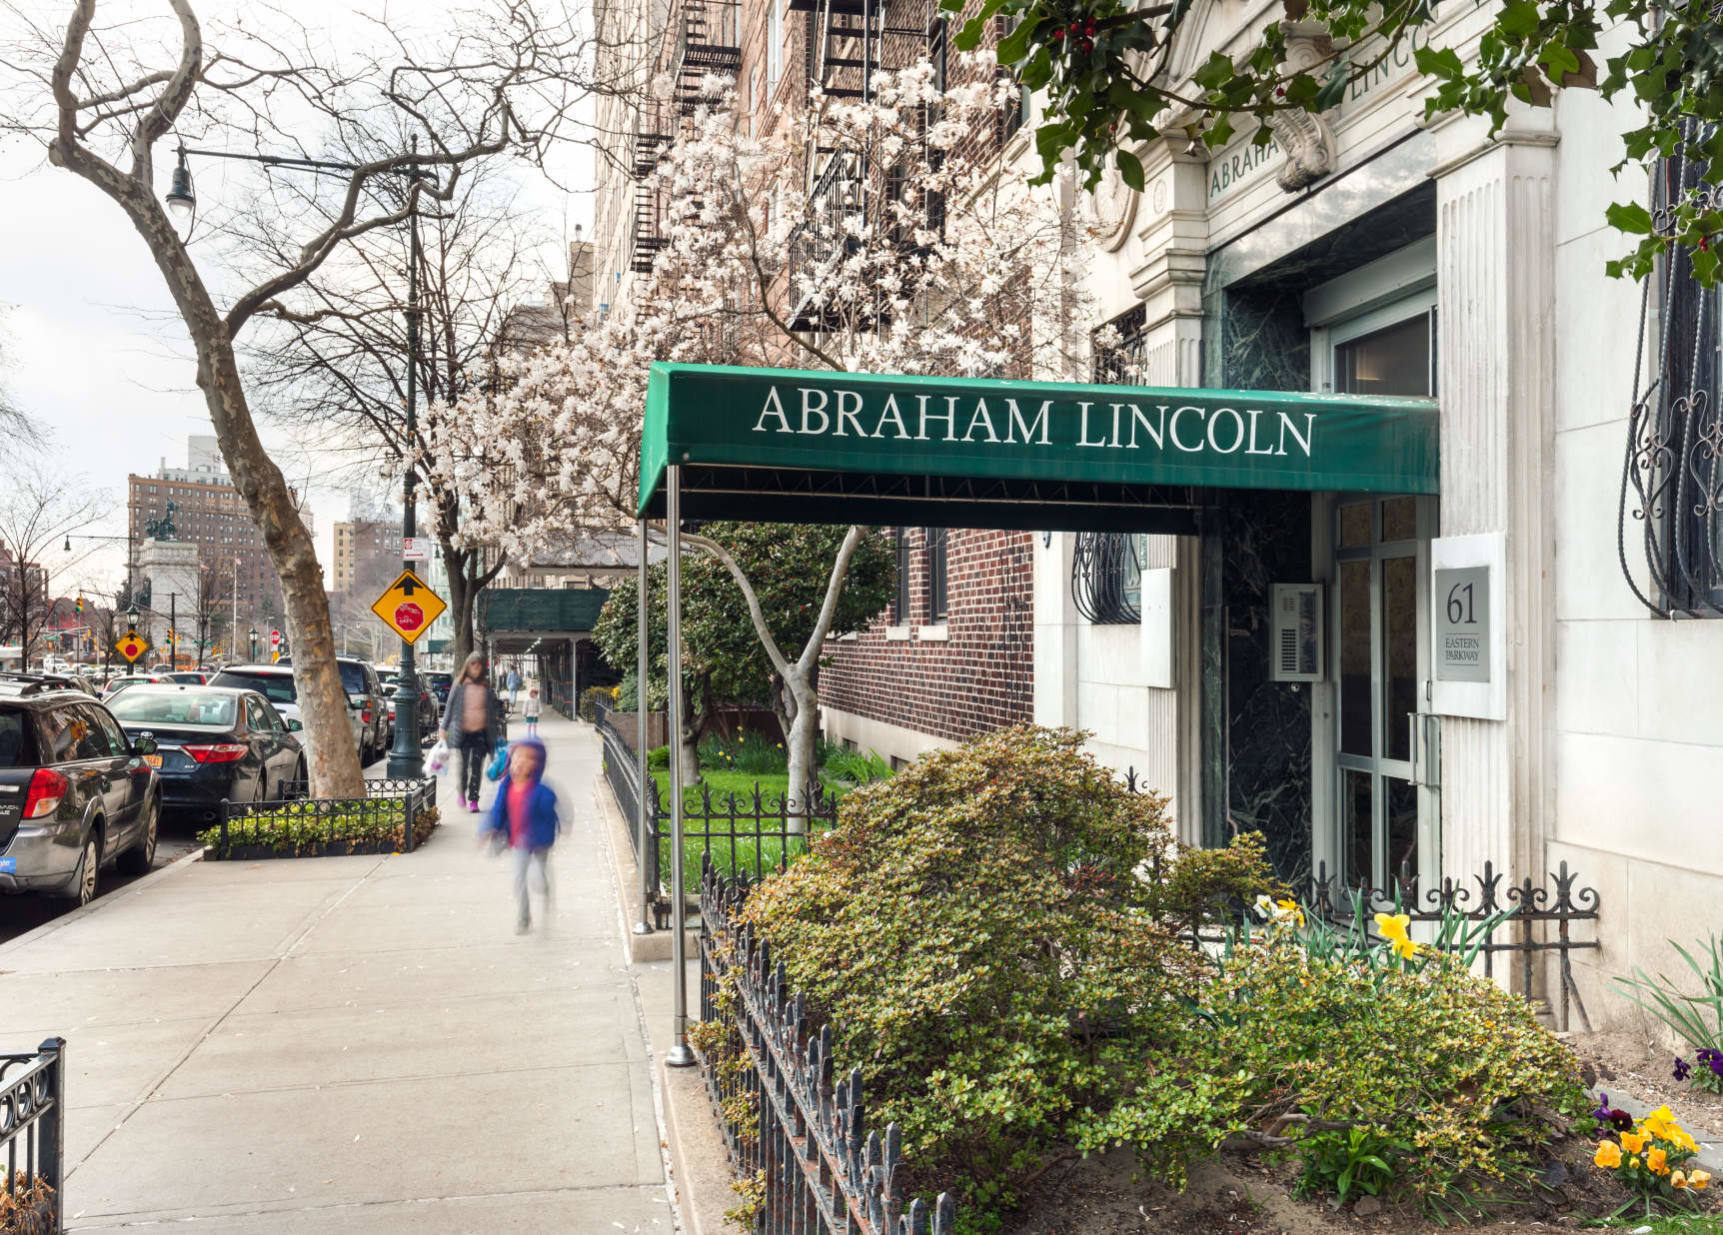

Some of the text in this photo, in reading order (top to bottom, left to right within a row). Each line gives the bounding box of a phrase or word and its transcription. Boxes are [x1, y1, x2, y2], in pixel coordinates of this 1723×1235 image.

[1210, 139, 1280, 198] ABRAHA
[752, 385, 1318, 457] ABRAHAM LINCOLN
[1447, 582, 1478, 625] 61
[1445, 637, 1480, 649] EASTERN
[1445, 650, 1480, 661] PARKWAY
